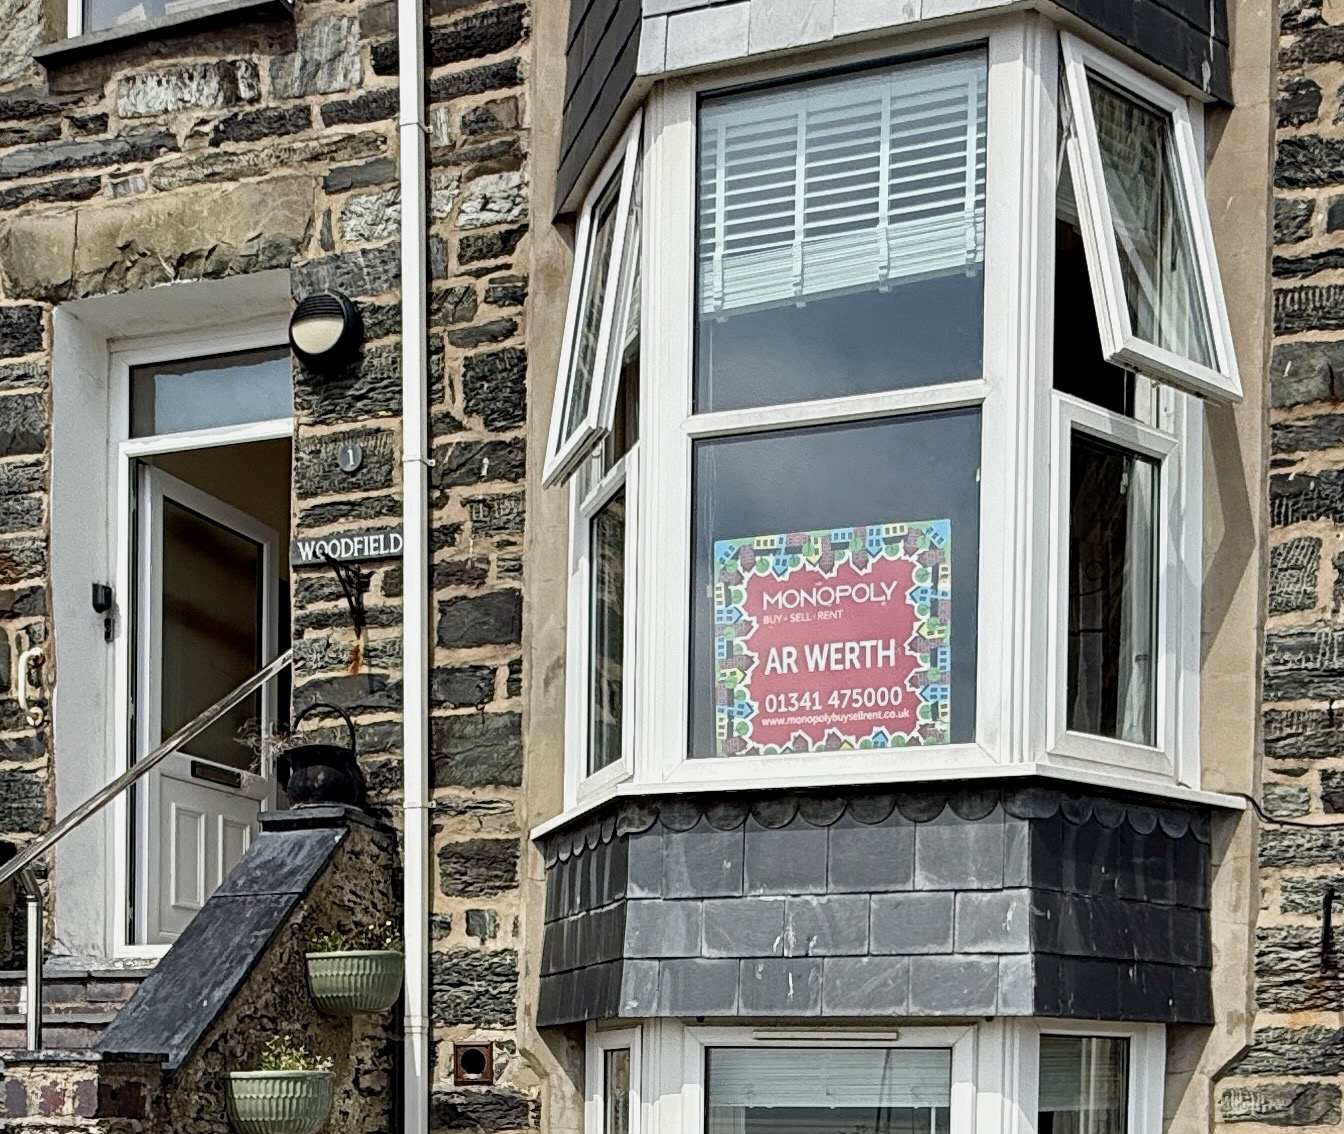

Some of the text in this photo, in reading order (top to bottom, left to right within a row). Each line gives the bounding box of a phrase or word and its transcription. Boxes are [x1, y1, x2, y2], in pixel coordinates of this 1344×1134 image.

[347, 449, 355, 466] 1
[297, 533, 403, 561] WOODFIELD
[763, 581, 897, 610] MONOPOLY
[763, 610, 843, 625] BUY SELL RENT
[765, 639, 896, 675] AR WERTH
[765, 686, 902, 713] 01341 475000
[761, 708, 910, 726] www.monopolybuysellrent.co.uk
